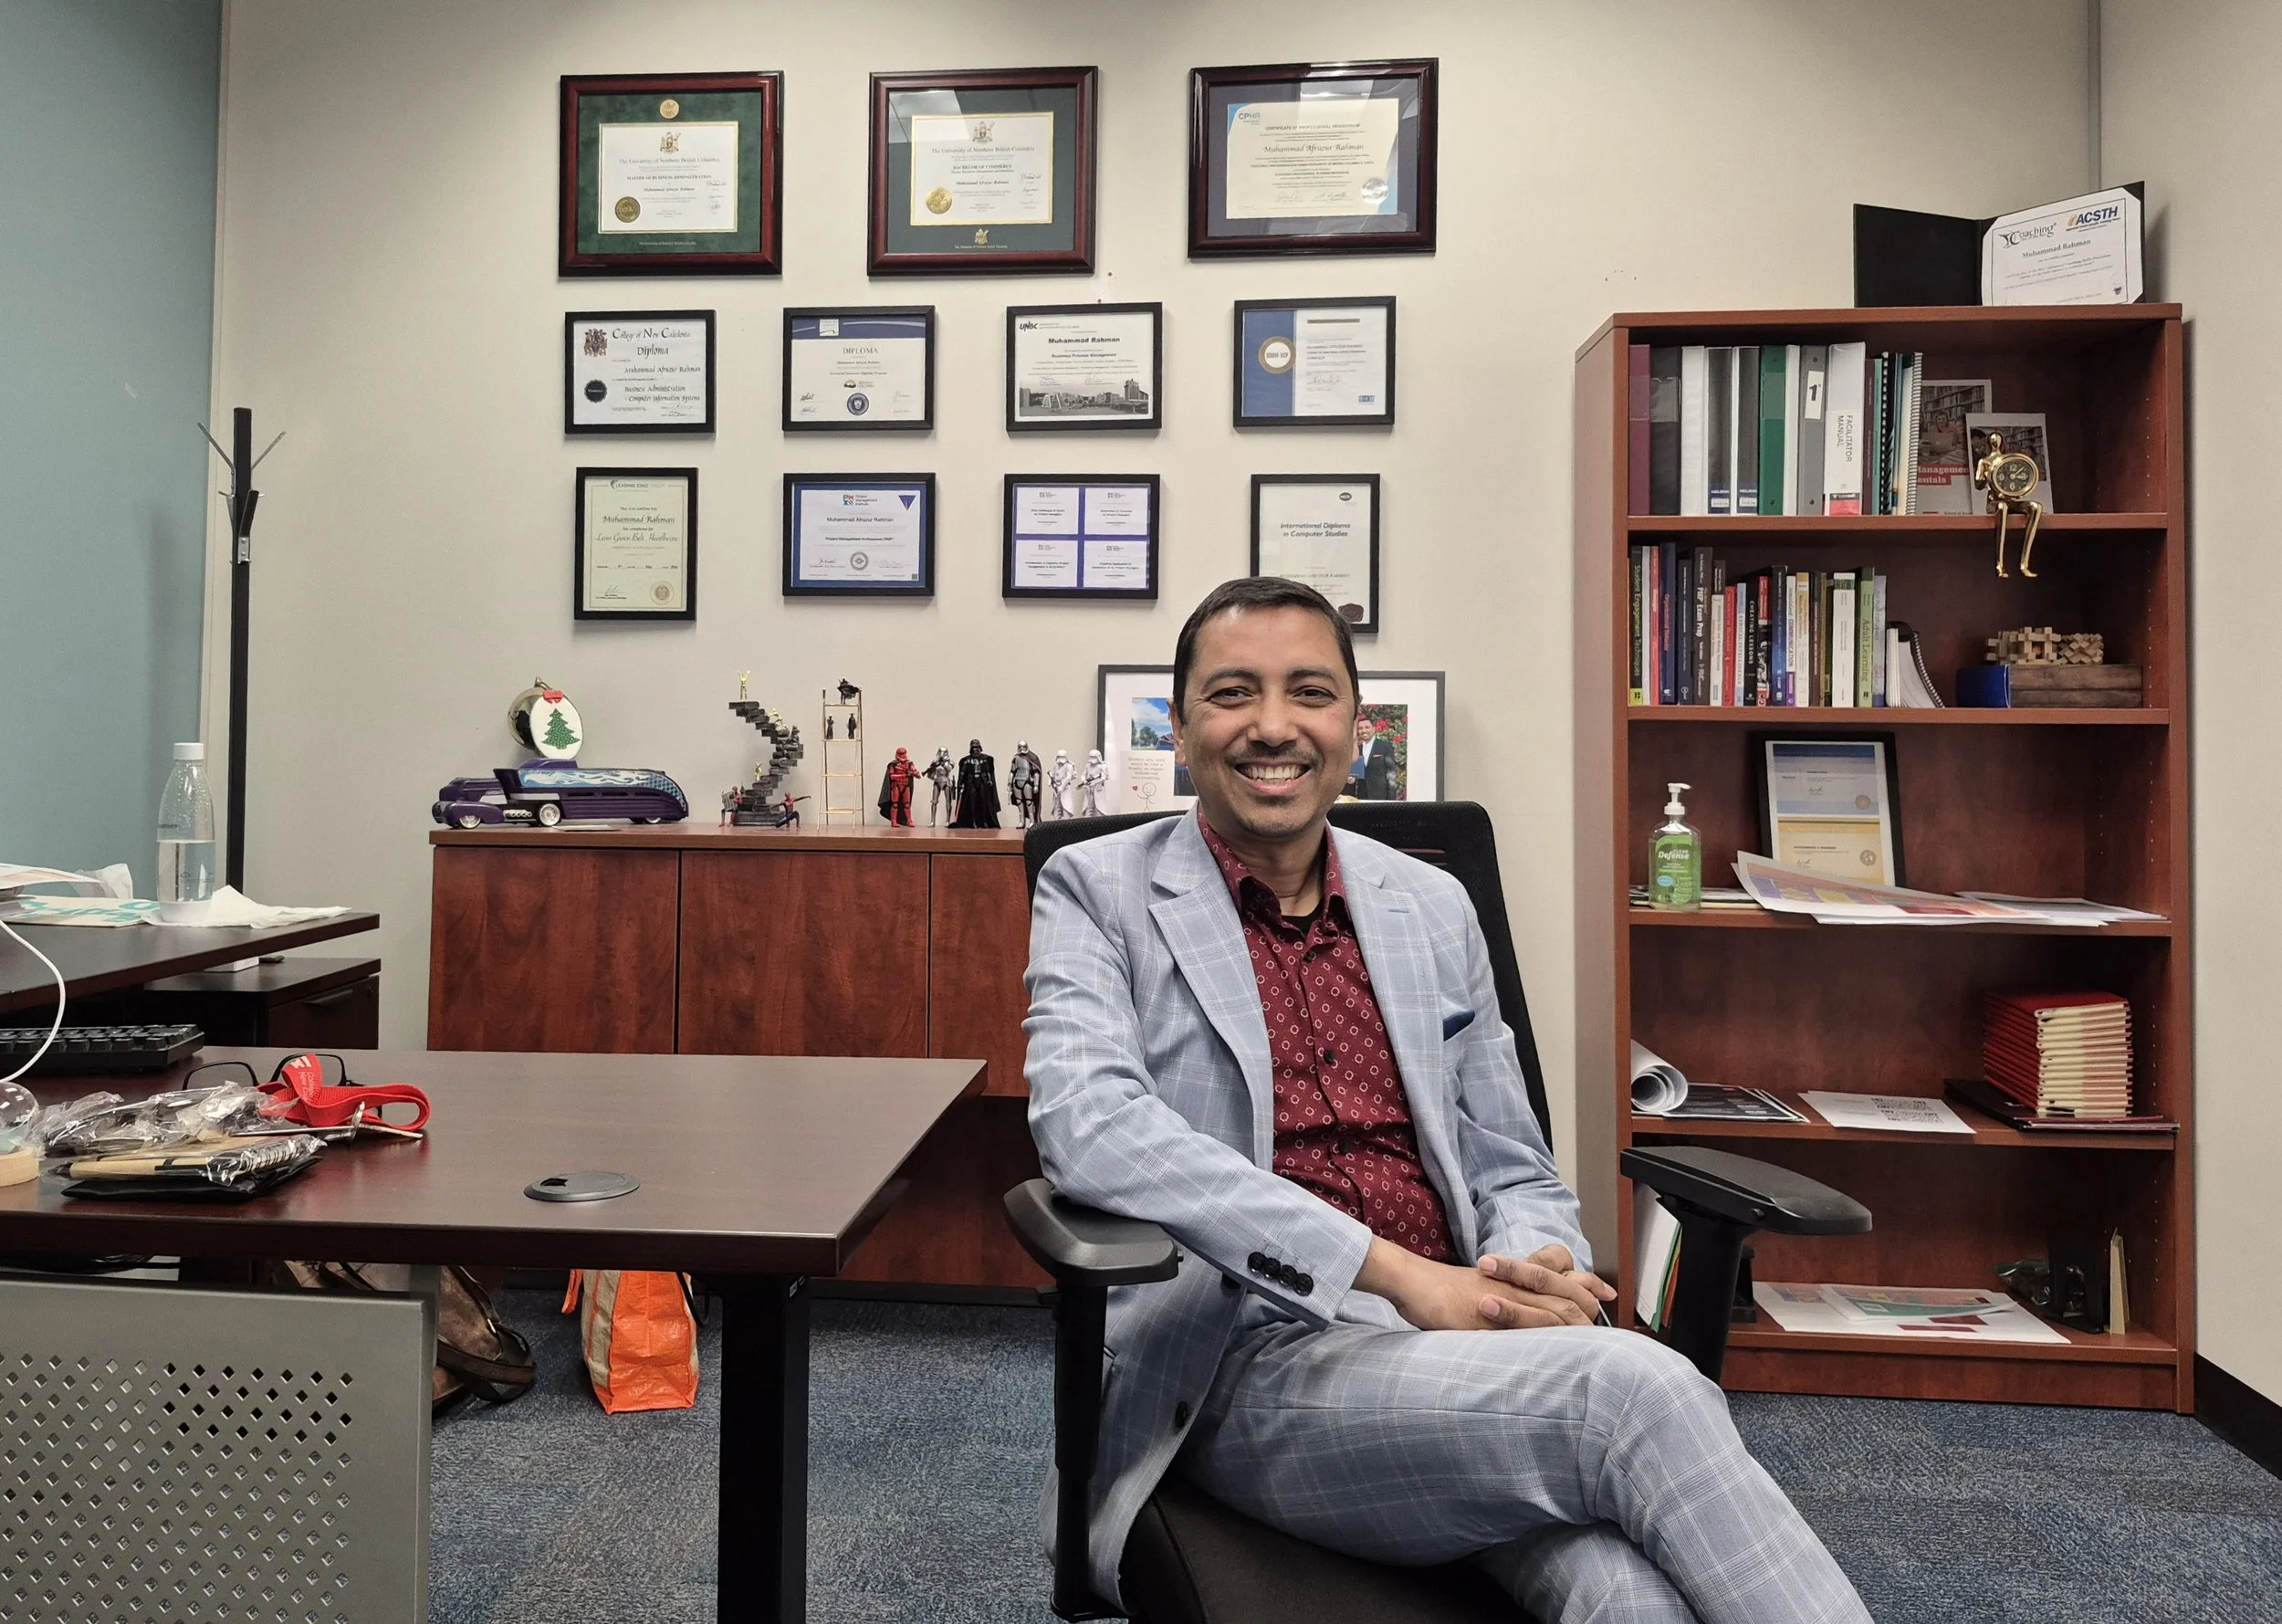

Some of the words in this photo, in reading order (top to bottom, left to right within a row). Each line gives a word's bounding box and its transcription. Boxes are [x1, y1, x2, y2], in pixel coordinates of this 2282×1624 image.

[1263, 144, 1304, 153] Muhammad
[1334, 142, 1364, 151] Rahman
[2076, 206, 2118, 225] ACSTH
[2022, 245, 2061, 258] Muhammad
[2062, 239, 2091, 250] Rahman
[612, 328, 634, 341] College
[644, 328, 658, 339] New
[661, 327, 690, 339] Caledonia
[636, 343, 669, 359] Diploma
[1918, 466, 1969, 475] anagemen
[602, 514, 644, 523] Muhammad
[646, 514, 675, 523] Rahman
[1323, 522, 1351, 530] Diploma
[1633, 593, 1641, 637] Engagement
[1695, 623, 1704, 637] Prep
[1862, 619, 1870, 642] Adult
[1633, 639, 1641, 676] Techniques
[1860, 644, 1869, 682] Learning
[1658, 850, 1691, 860] Defense
